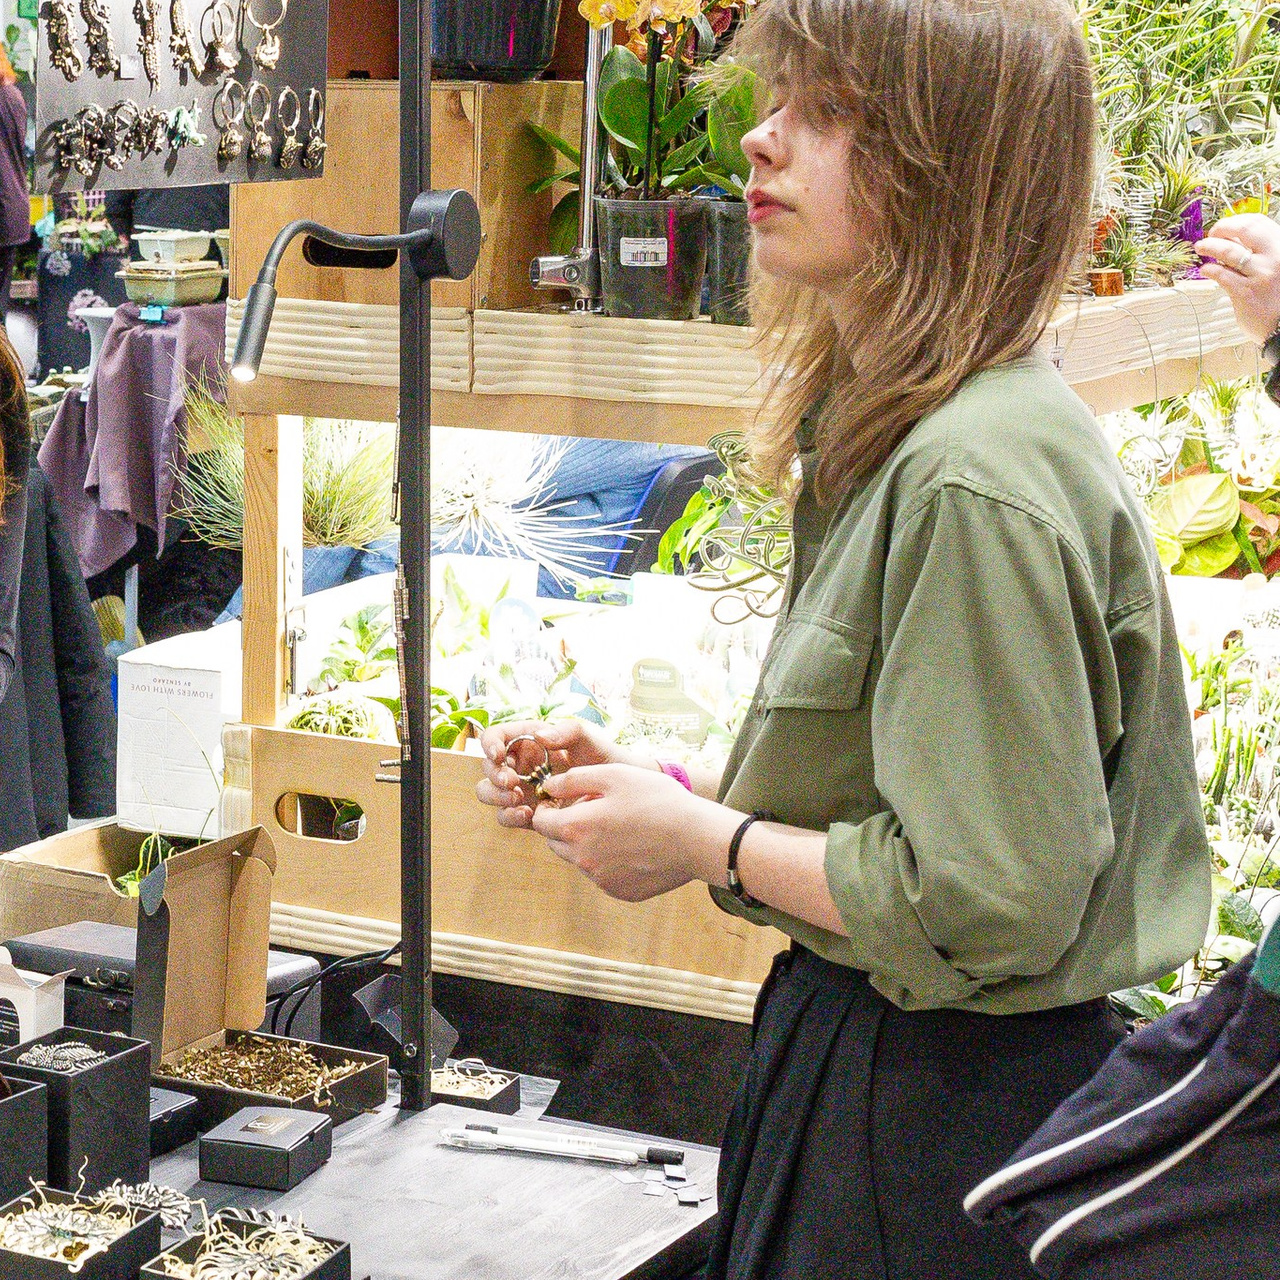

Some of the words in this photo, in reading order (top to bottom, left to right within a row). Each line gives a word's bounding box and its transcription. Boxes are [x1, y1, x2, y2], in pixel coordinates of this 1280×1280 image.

[130, 683, 150, 693] LOVE
[153, 686, 174, 695] WITH
[177, 688, 213, 699] FLOWERS
